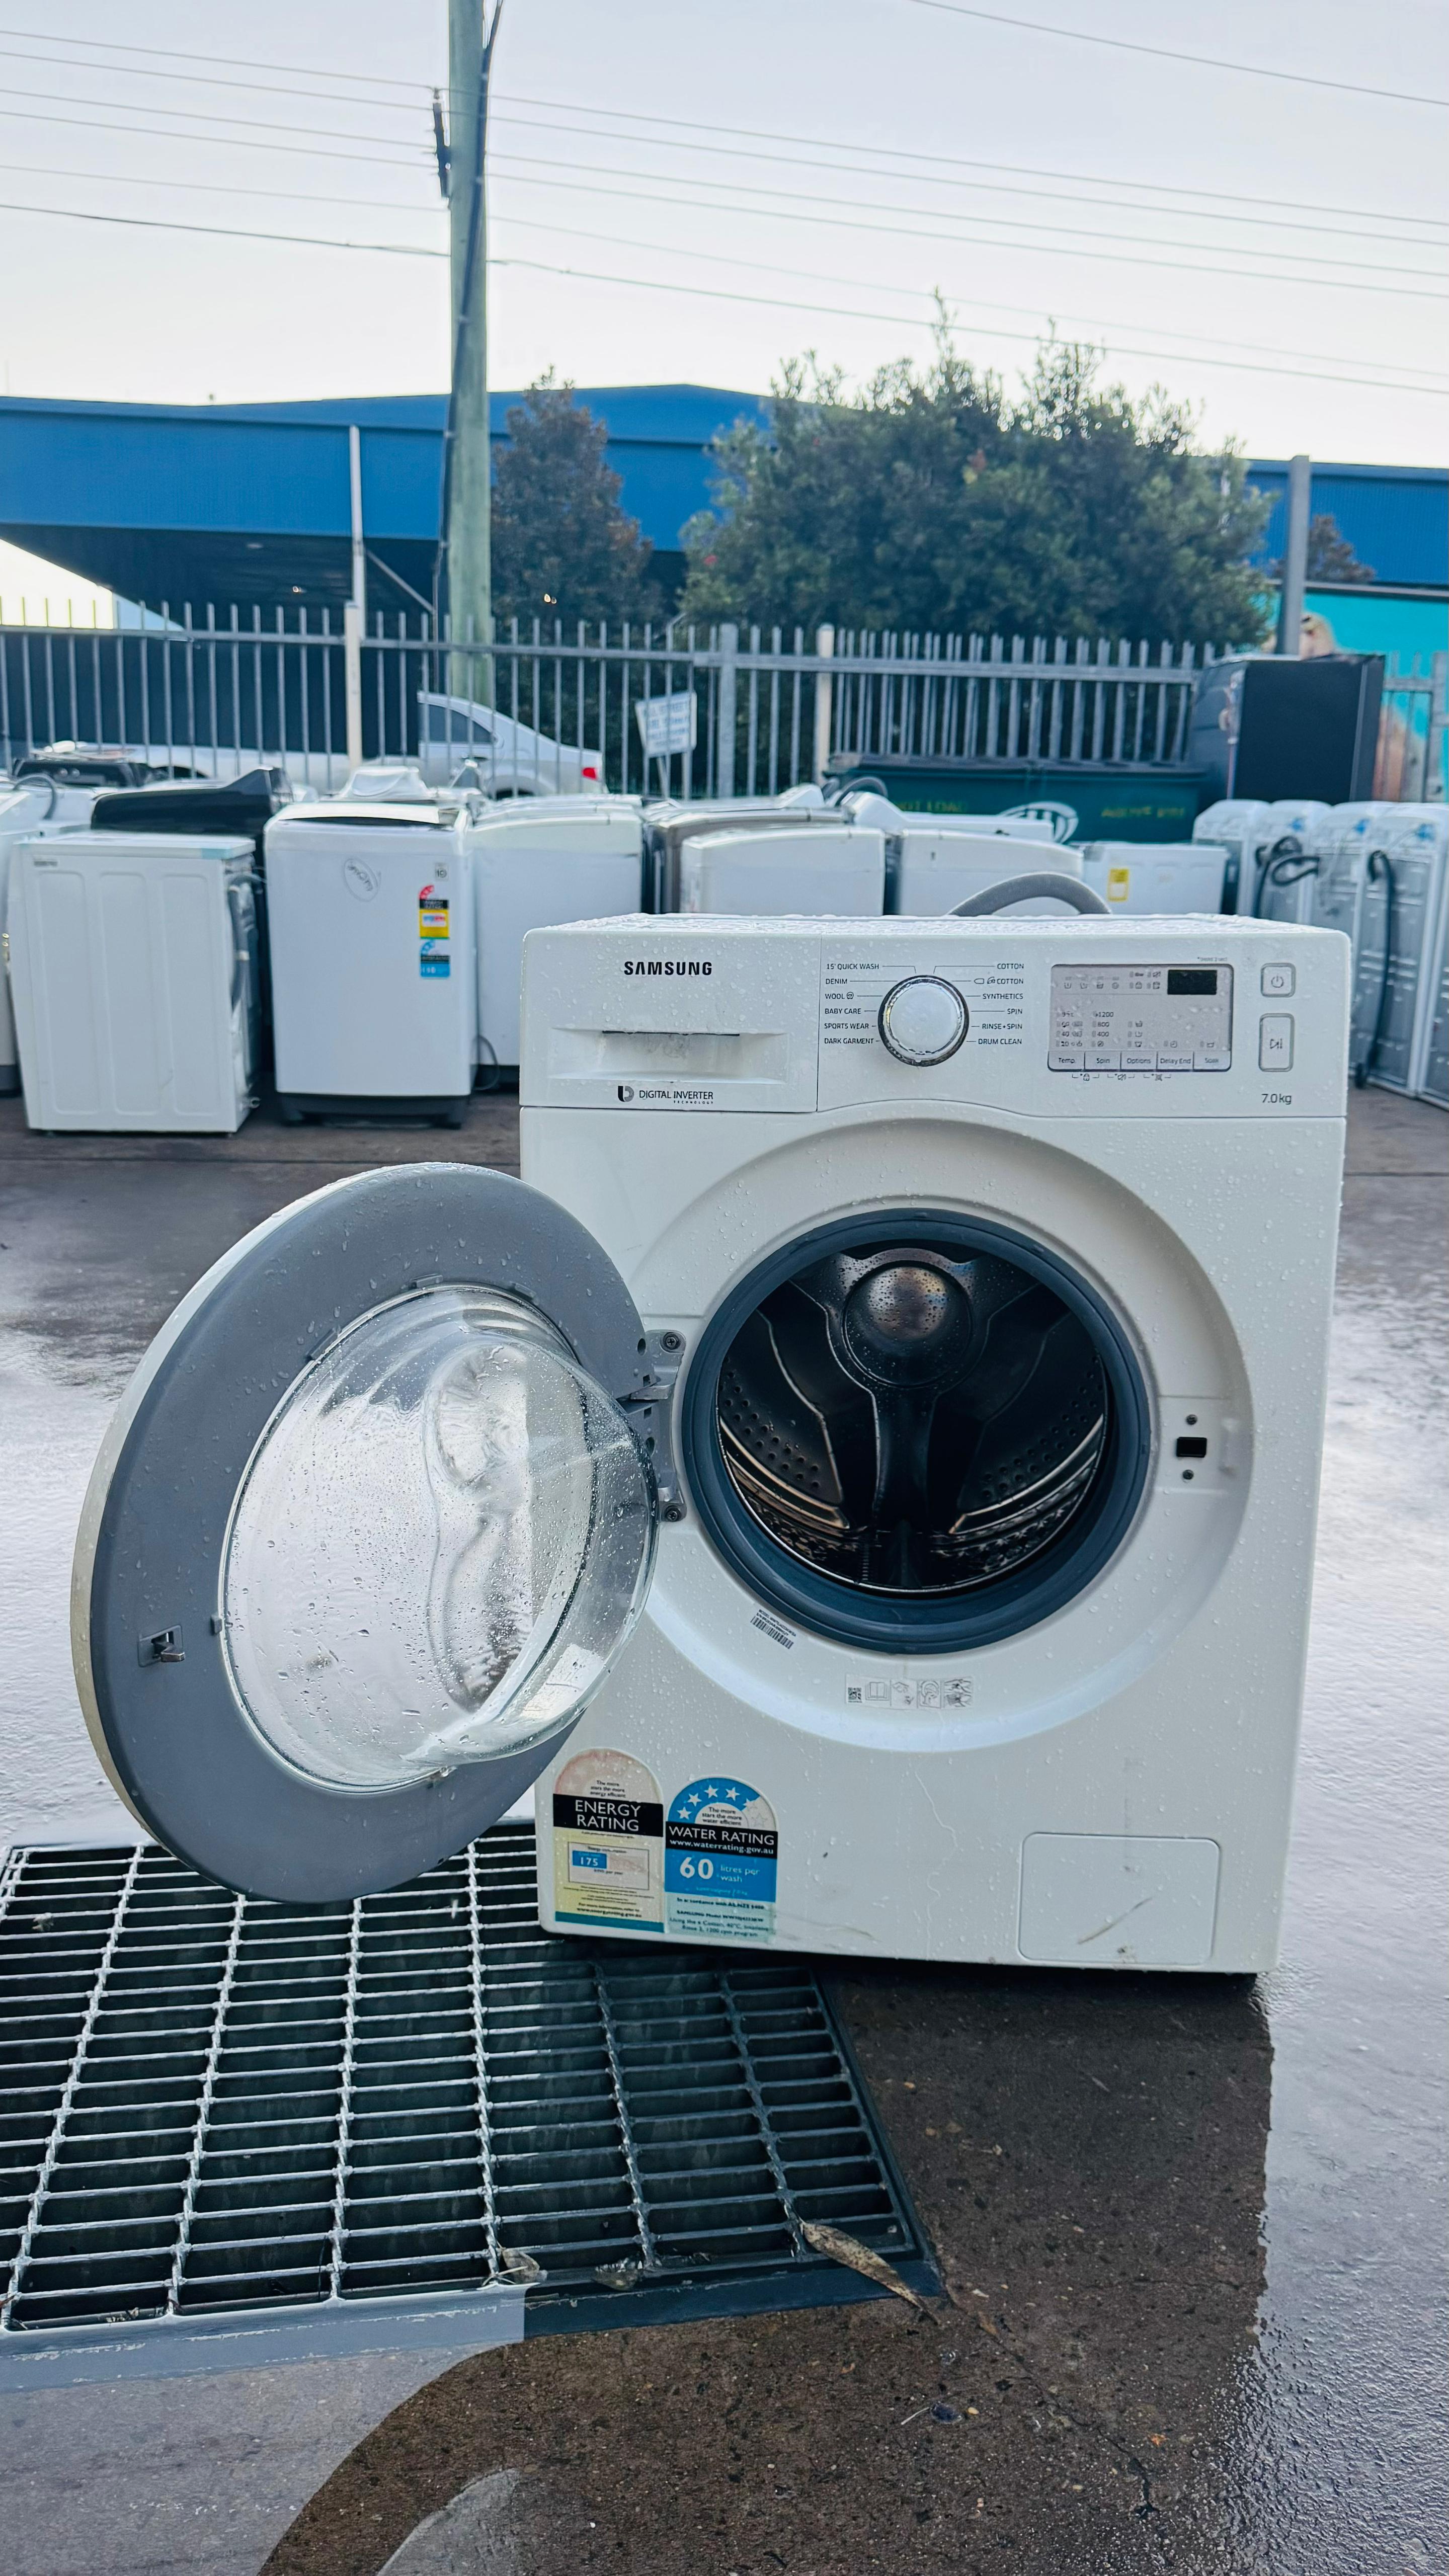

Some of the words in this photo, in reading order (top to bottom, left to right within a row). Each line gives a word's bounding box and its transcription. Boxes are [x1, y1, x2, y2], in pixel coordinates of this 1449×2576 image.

[624, 961, 712, 976] SAMSUNG
[639, 1090, 671, 1098] DIGITAL
[673, 1091, 713, 1099] INVERTER
[575, 1799, 641, 1817] ENERGY
[577, 1814, 639, 1832] RATING
[669, 1826, 717, 1840] WATER
[721, 1831, 775, 1845] RATING
[670, 1839, 774, 1855] www.waterrating.gov.au
[581, 1857, 598, 1867] 175
[680, 1857, 714, 1880] 60
[720, 1875, 742, 1883] wash
